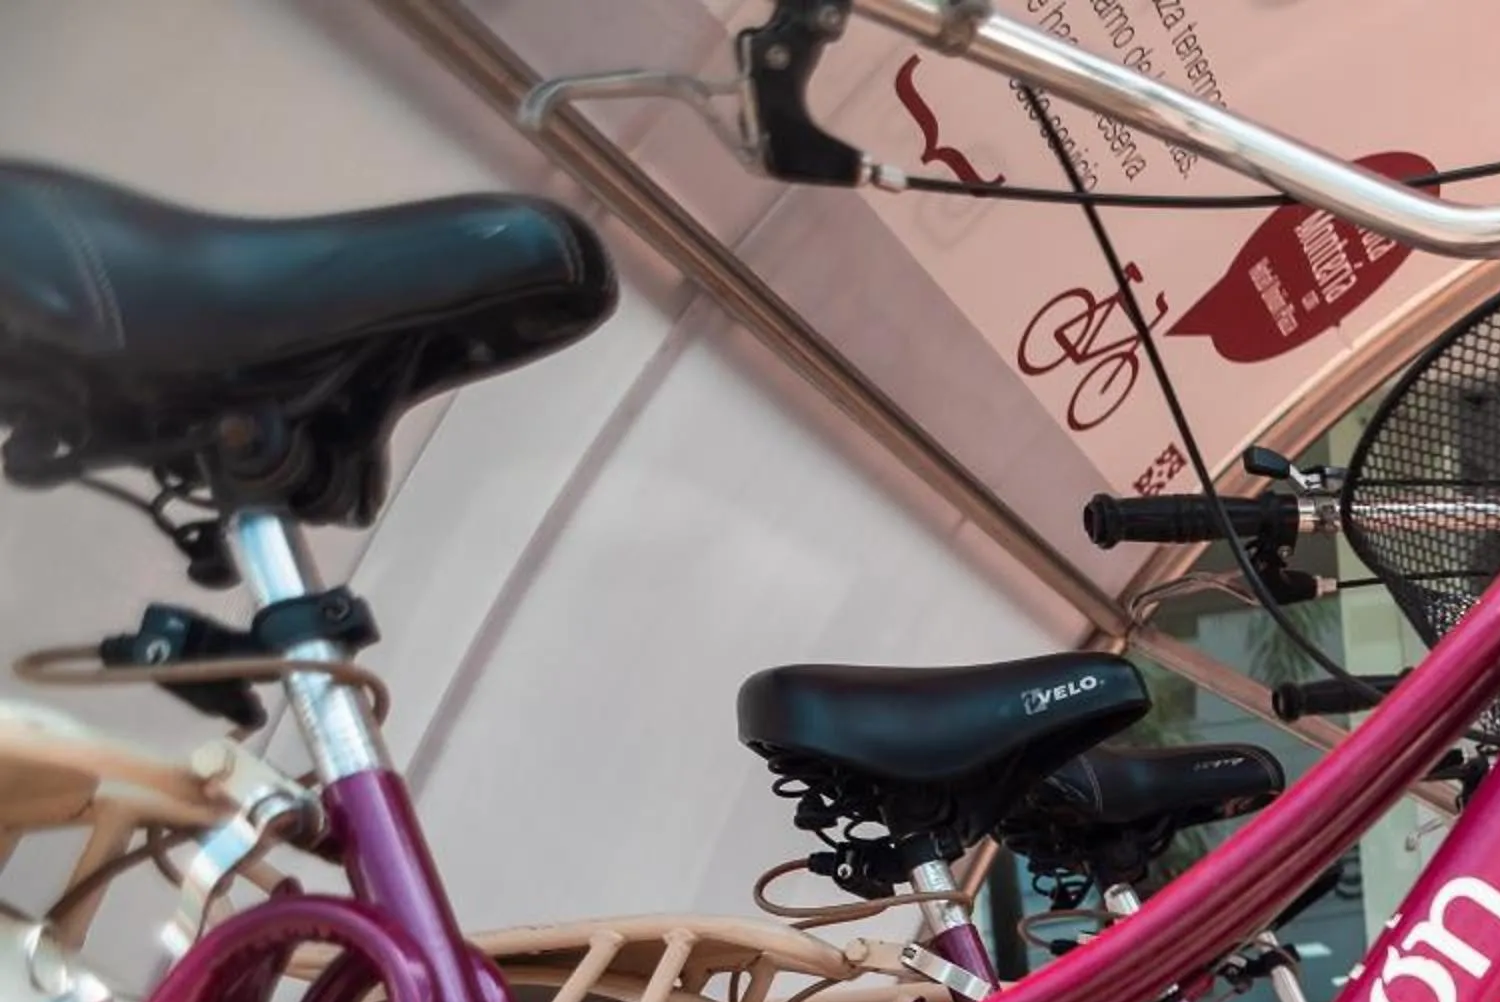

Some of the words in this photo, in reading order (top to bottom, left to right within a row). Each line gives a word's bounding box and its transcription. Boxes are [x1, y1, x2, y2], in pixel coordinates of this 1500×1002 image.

[1090, 0, 1135, 48] amo
[1172, 21, 1228, 108] tenemo
[1096, 112, 1147, 183] eserva
[1294, 209, 1363, 304] Montería
[1037, 675, 1097, 703] VELO
